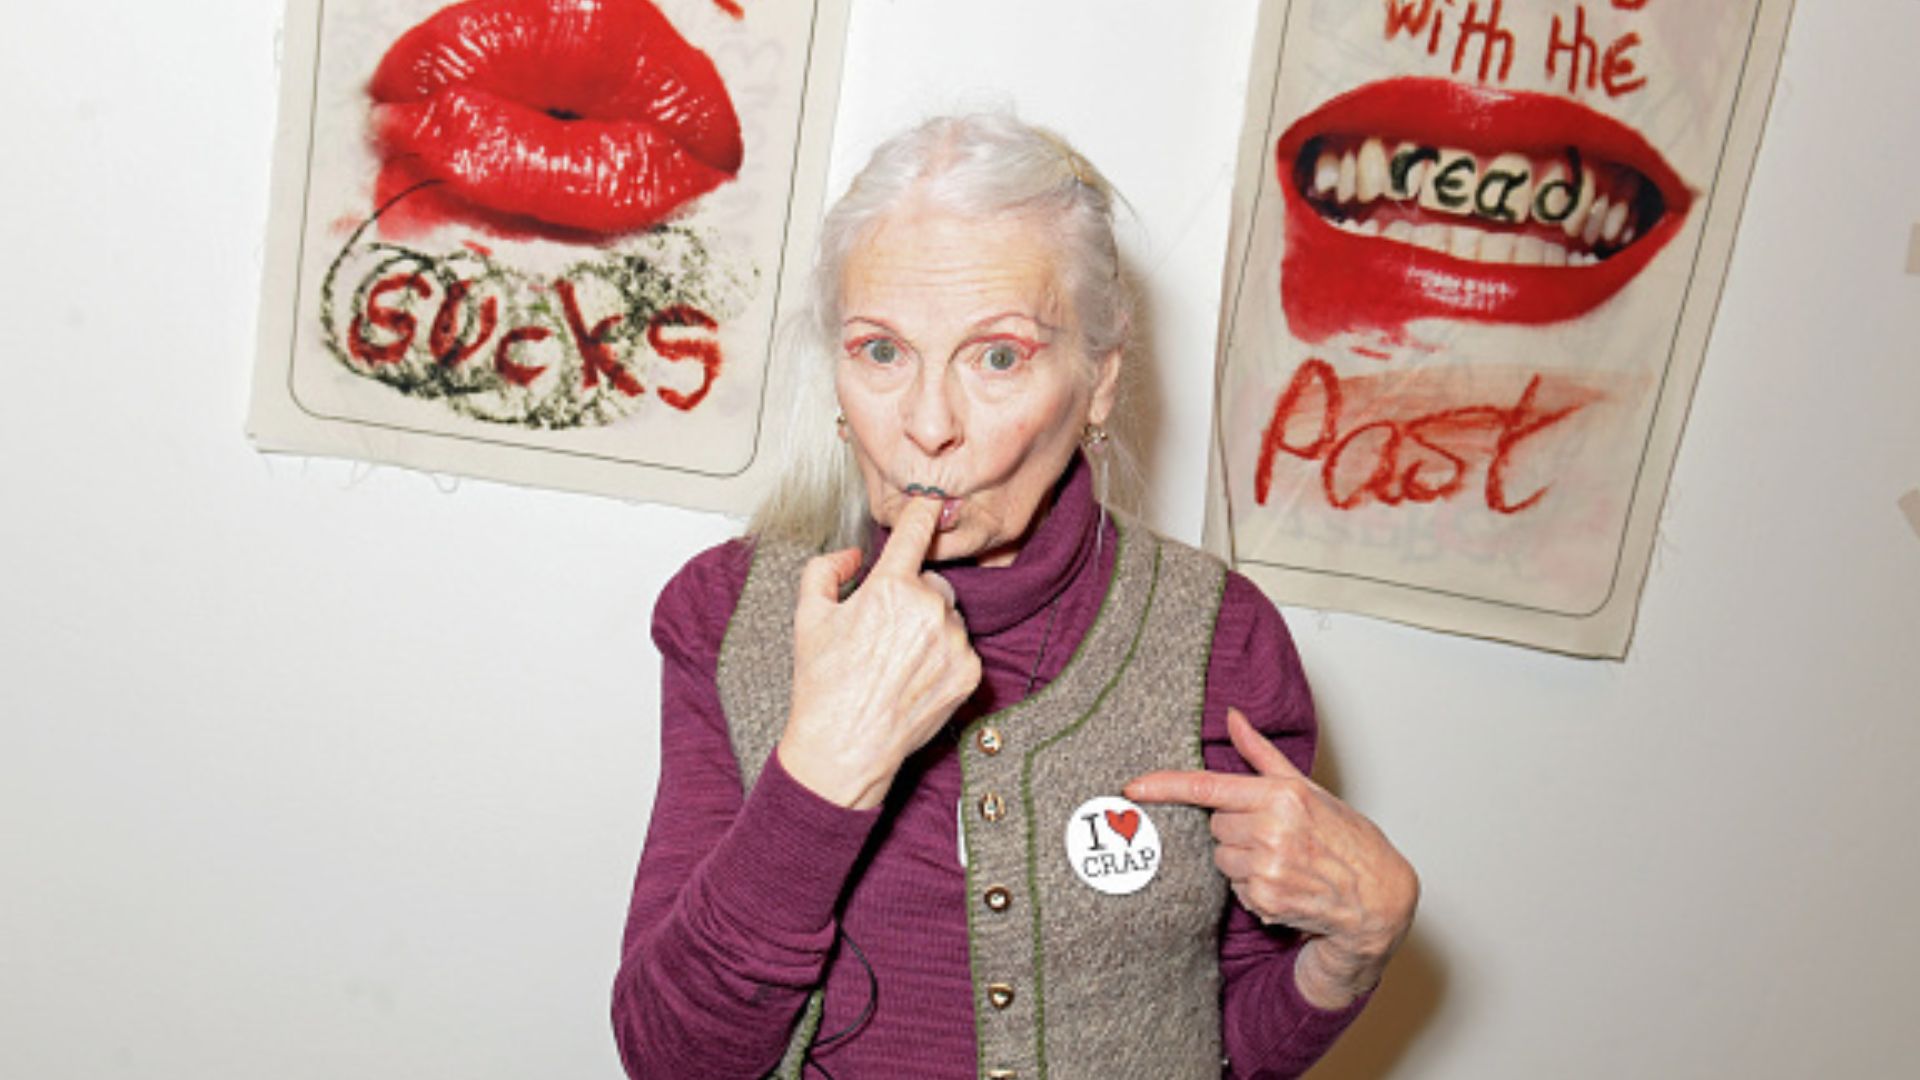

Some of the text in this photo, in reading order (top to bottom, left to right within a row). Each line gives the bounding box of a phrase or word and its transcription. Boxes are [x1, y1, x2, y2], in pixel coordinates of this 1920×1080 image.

[1384, 0, 1515, 82] with
[1389, 146, 1584, 222] read
[1081, 812, 1106, 851] I
[1083, 847, 1156, 877] CRAP
